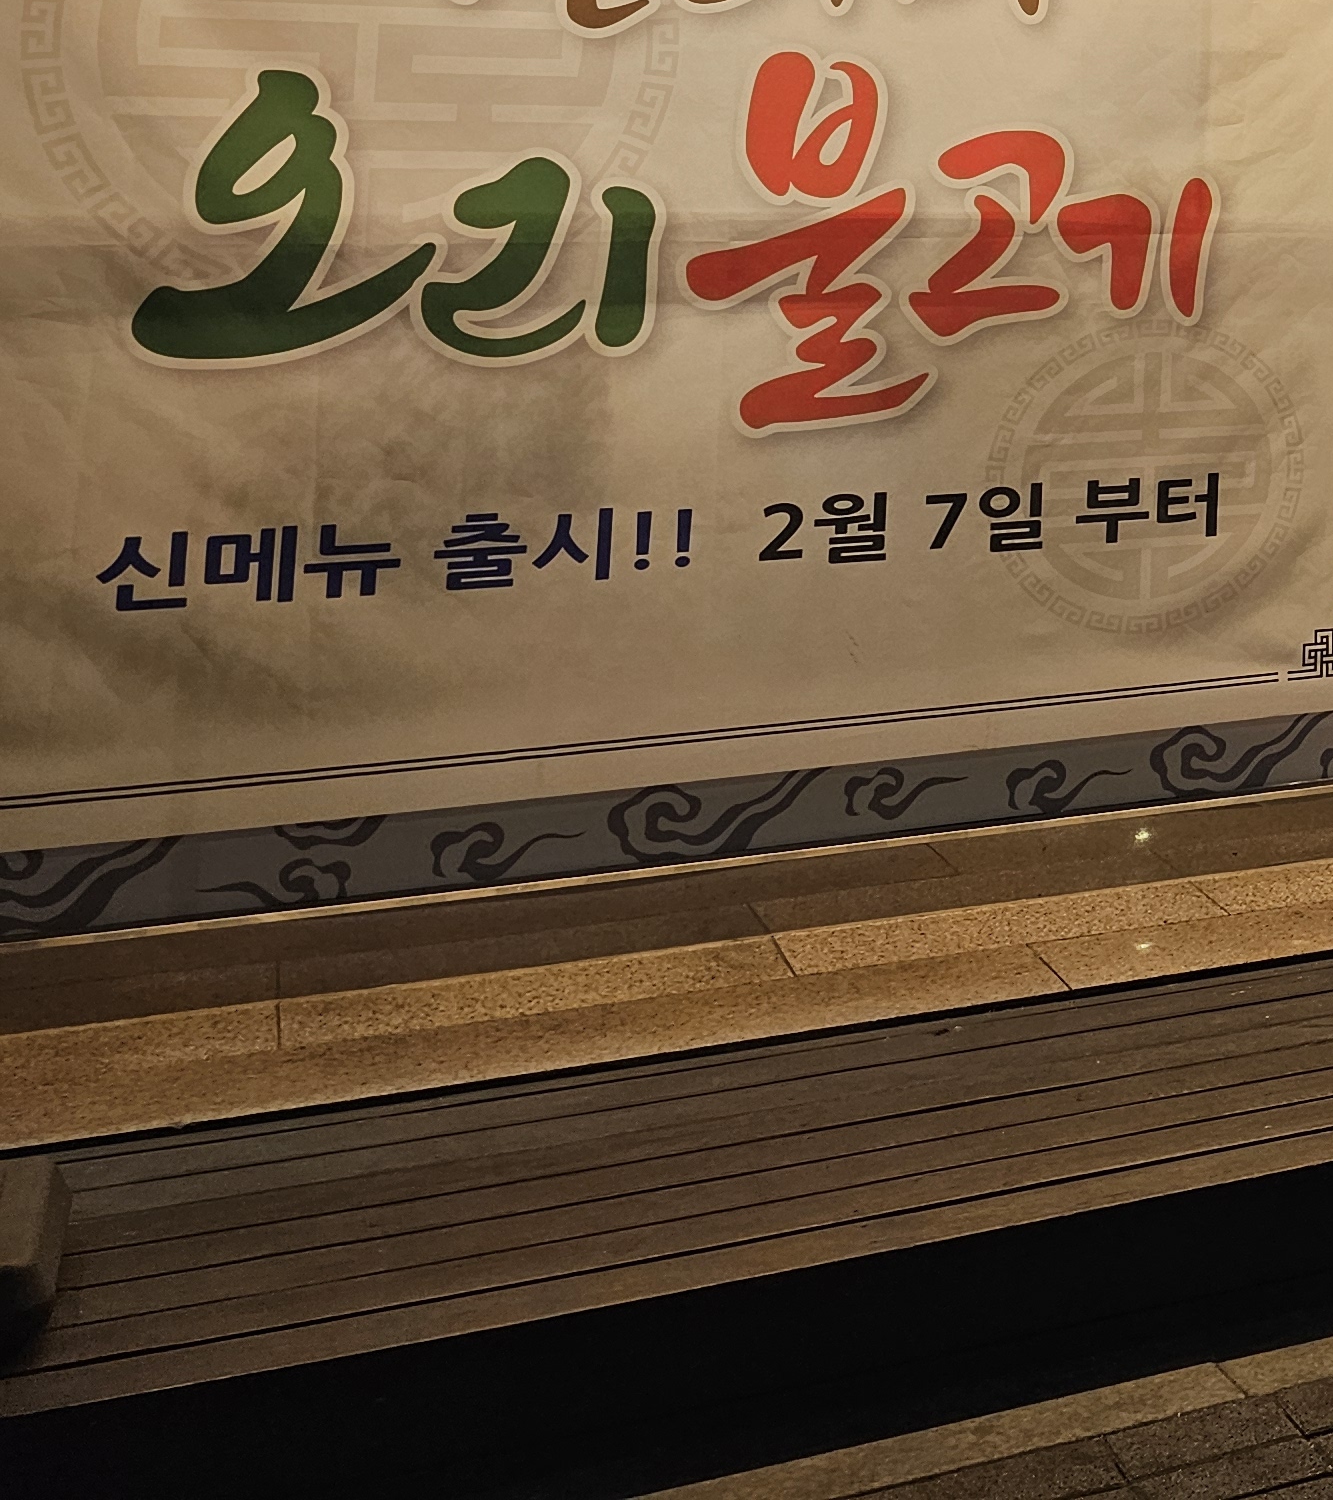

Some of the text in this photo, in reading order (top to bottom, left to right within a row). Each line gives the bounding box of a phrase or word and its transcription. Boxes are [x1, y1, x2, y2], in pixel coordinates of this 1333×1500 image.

[130, 50, 1216, 431] 오리 불고기
[96, 471, 1224, 611] 신메뉴 출시!! 2월 7일 부터
